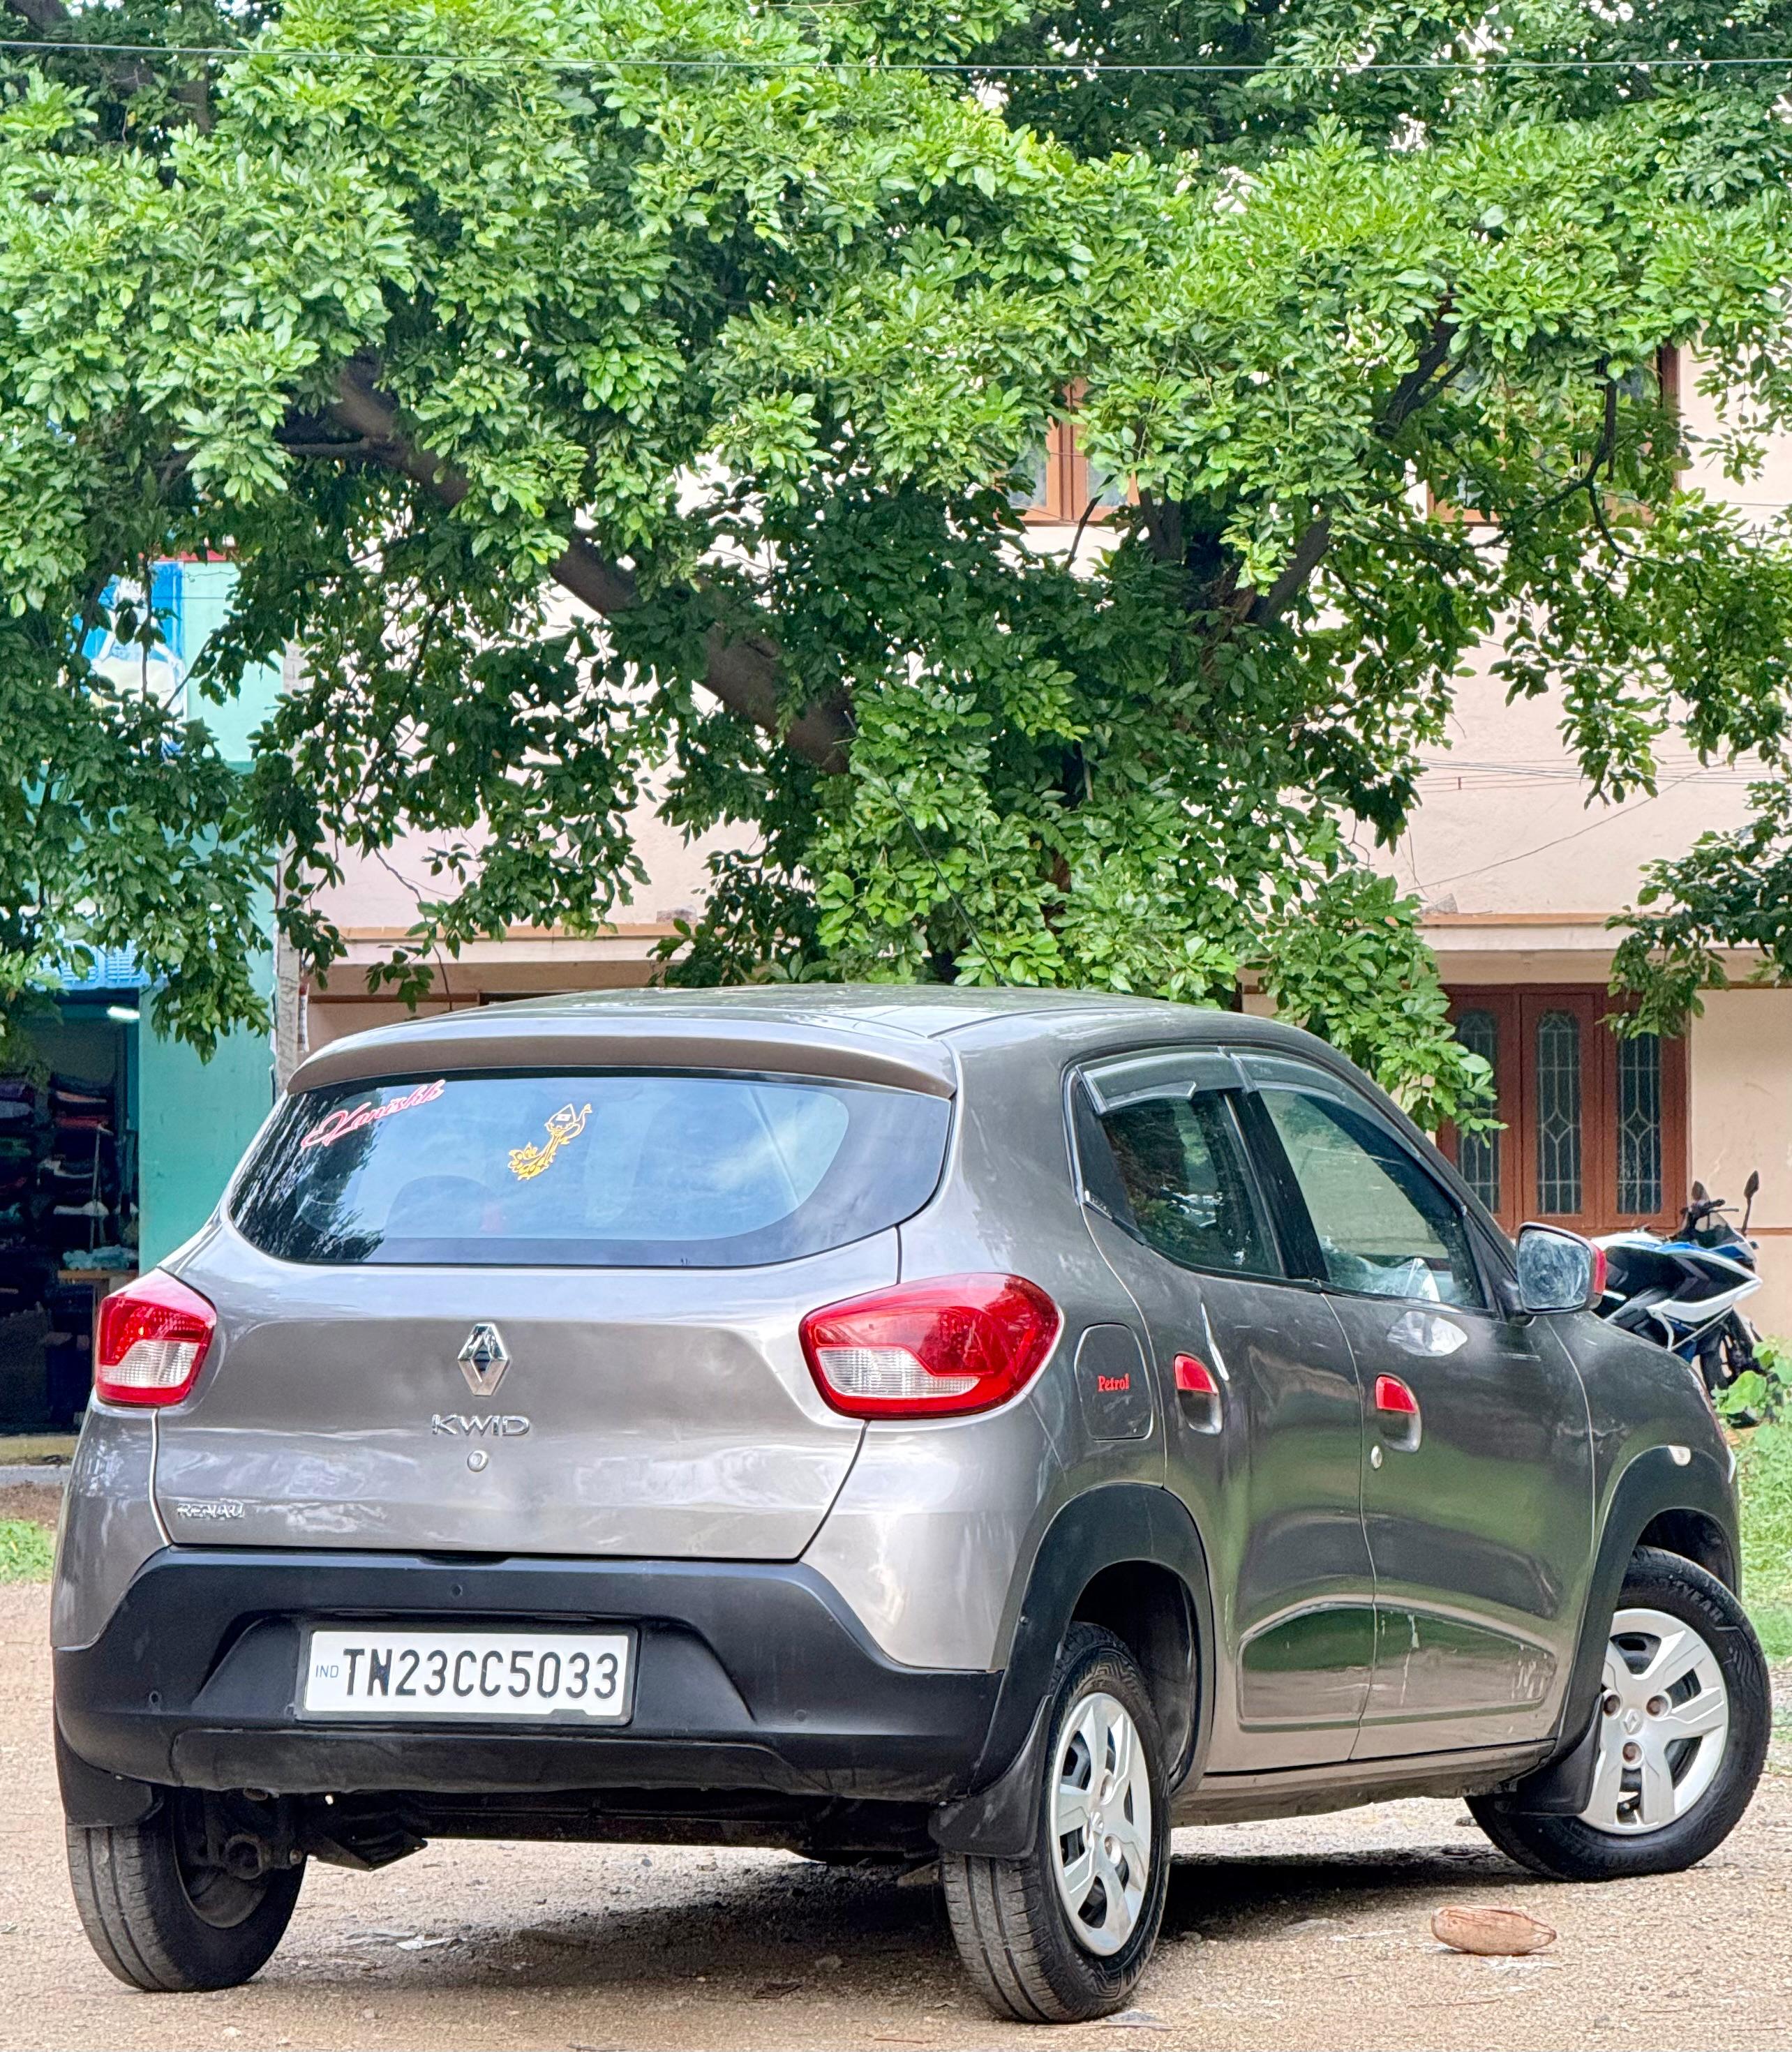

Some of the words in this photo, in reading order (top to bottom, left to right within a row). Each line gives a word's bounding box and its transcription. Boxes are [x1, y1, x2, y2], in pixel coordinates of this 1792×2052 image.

[1098, 1373, 1130, 1393] Petrol
[432, 1414, 530, 1437] KWID
[315, 1664, 340, 1679] IND
[343, 1647, 619, 1700] TN23CC5033
